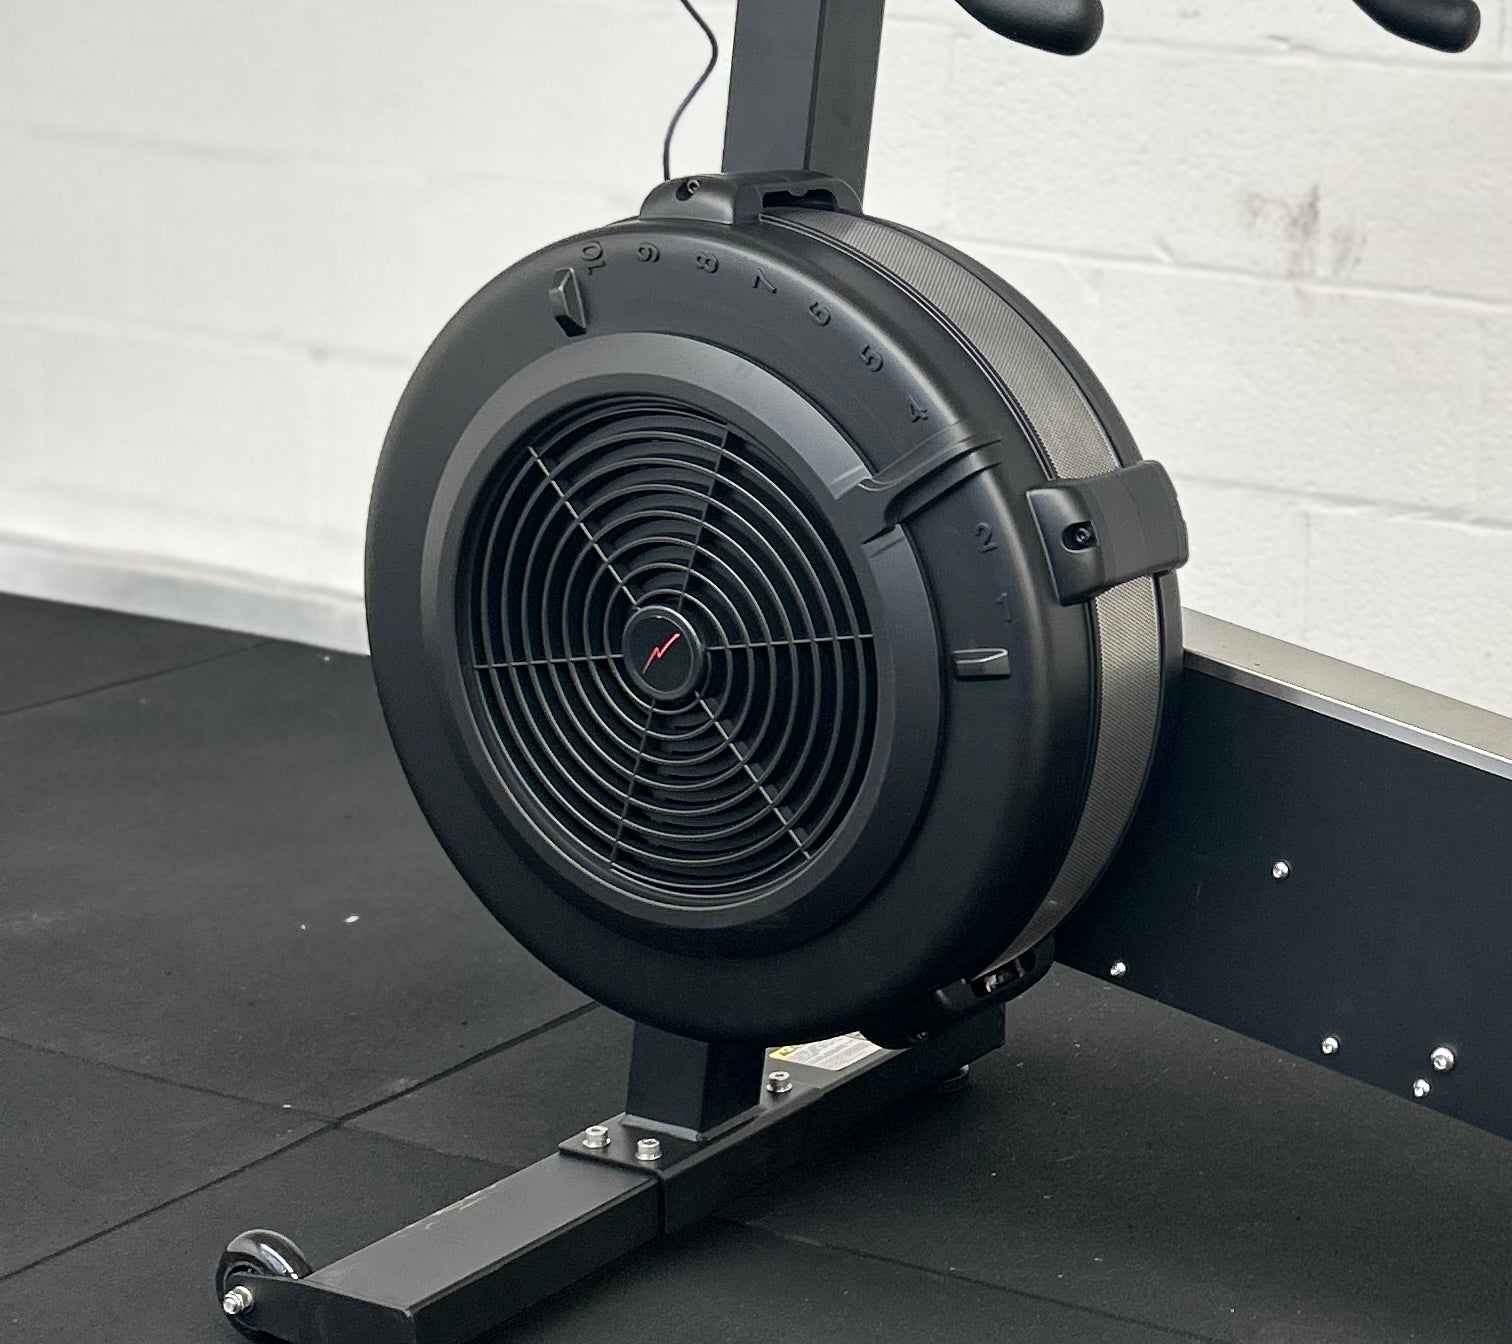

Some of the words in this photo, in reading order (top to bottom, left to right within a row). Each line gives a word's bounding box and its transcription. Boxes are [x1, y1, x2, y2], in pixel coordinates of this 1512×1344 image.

[696, 252, 719, 274] 8
[752, 267, 777, 295] 7
[860, 344, 884, 373] 5
[908, 395, 929, 424] 4
[975, 521, 999, 554] 2
